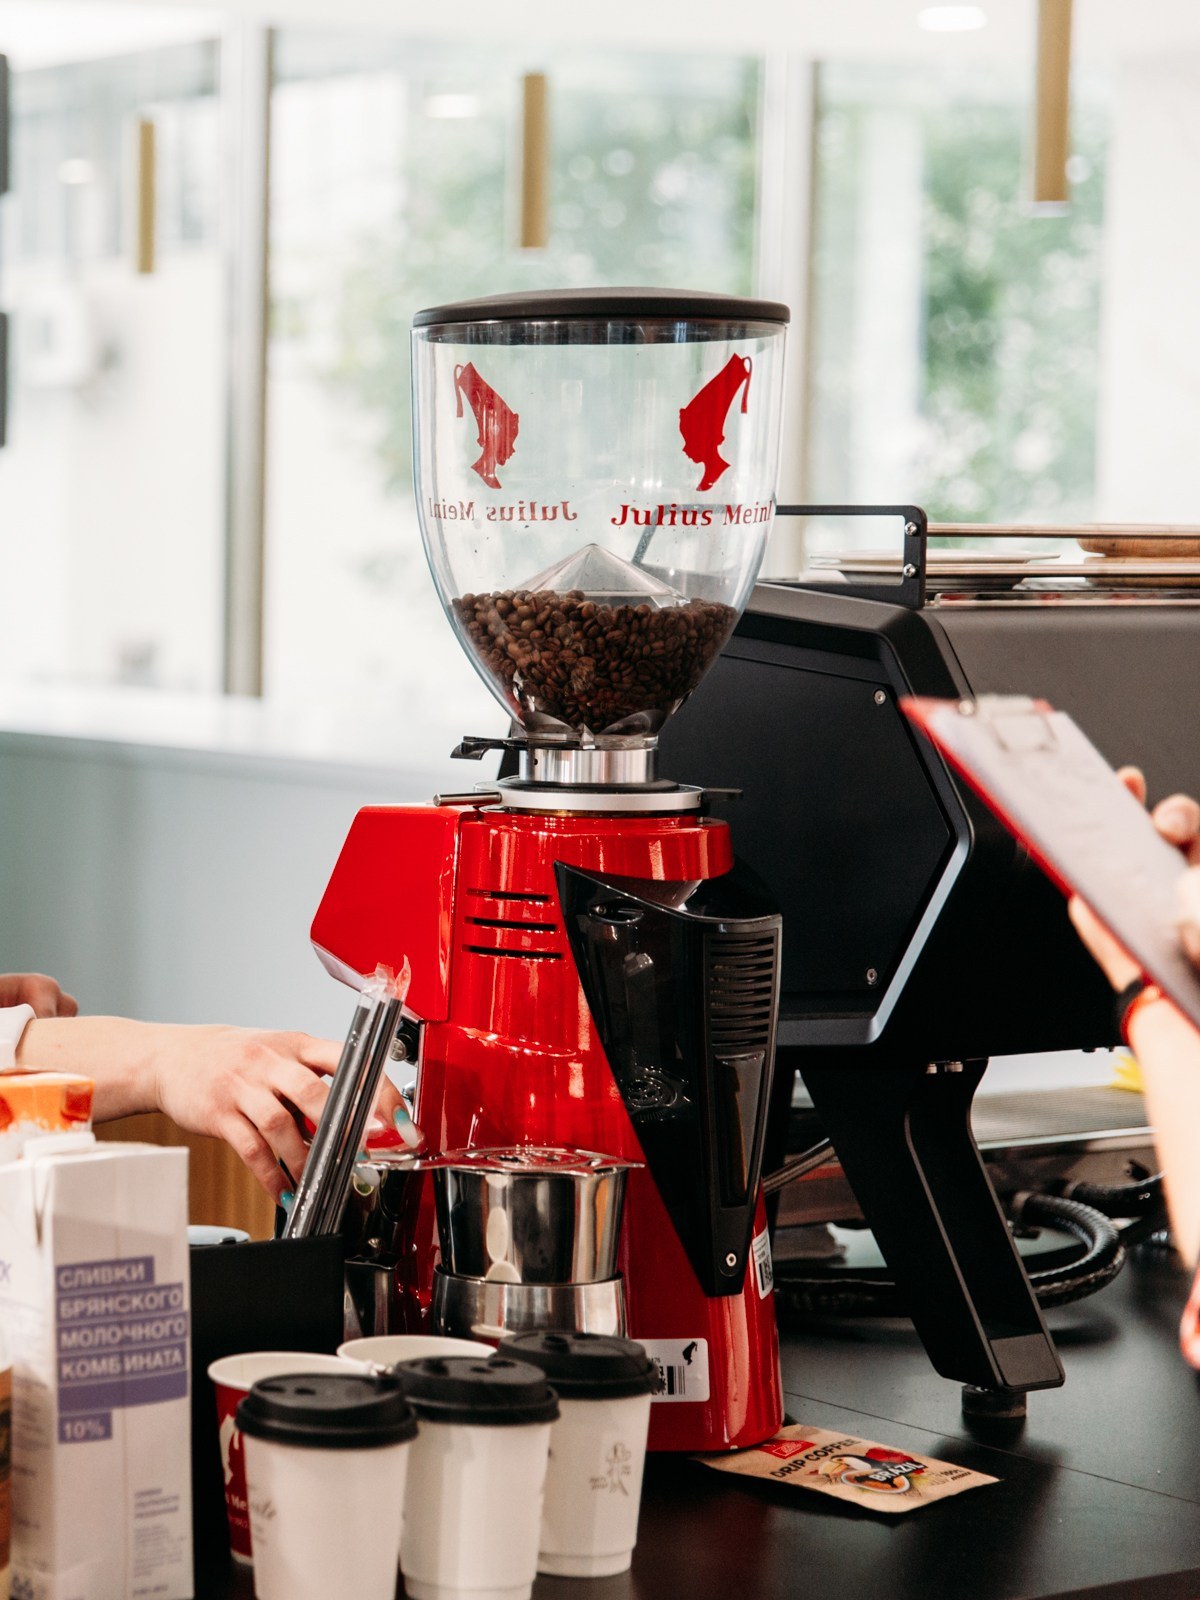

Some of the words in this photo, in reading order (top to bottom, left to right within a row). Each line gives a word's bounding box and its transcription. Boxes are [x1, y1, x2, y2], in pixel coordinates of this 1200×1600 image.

[610, 503, 713, 527] Julius
[722, 499, 773, 527] Meinl
[58, 1262, 145, 1289] СЛИВКИ
[59, 1288, 182, 1319] БРЯНСКОГО
[60, 1317, 187, 1349] МОЛОЧНОГО
[61, 1348, 183, 1380] КОМБИНАТА
[63, 1420, 105, 1440] 10%
[769, 1458, 807, 1479] DRIP
[868, 1461, 925, 1482] BRAZIL
